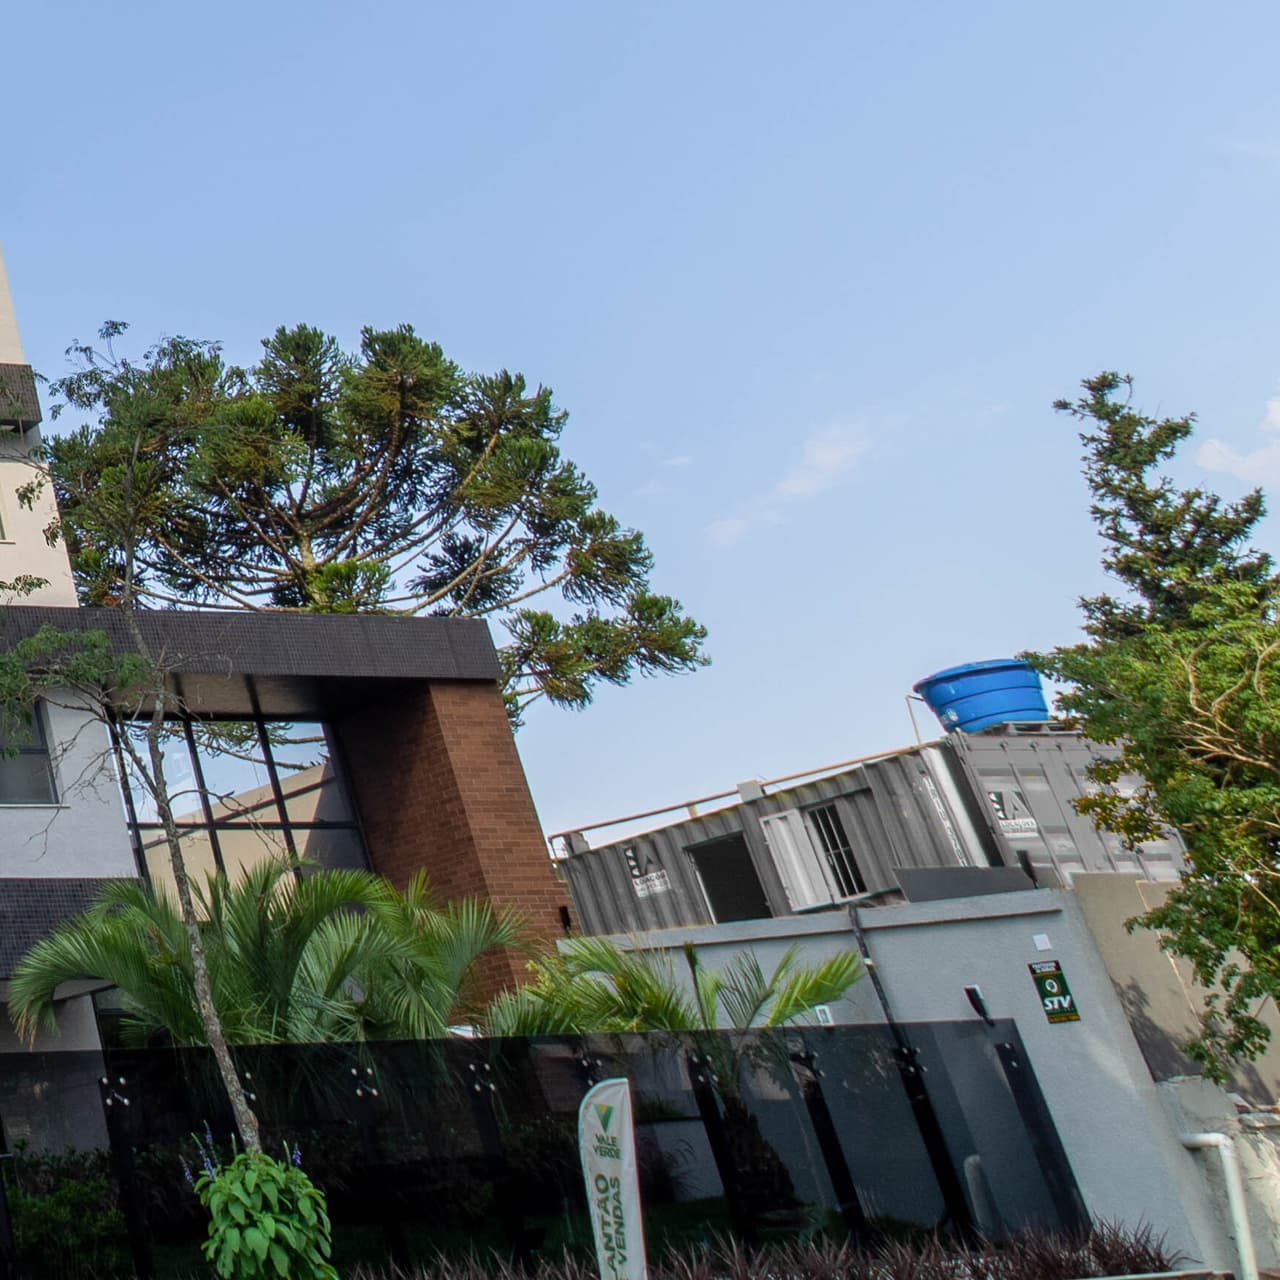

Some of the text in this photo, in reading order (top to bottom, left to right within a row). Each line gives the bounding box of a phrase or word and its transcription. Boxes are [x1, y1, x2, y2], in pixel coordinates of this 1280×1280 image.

[1043, 995, 1071, 1010] STV
[595, 1133, 617, 1148] VALE
[592, 1145, 622, 1161] VERDE
[609, 1176, 628, 1265] VENDAS
